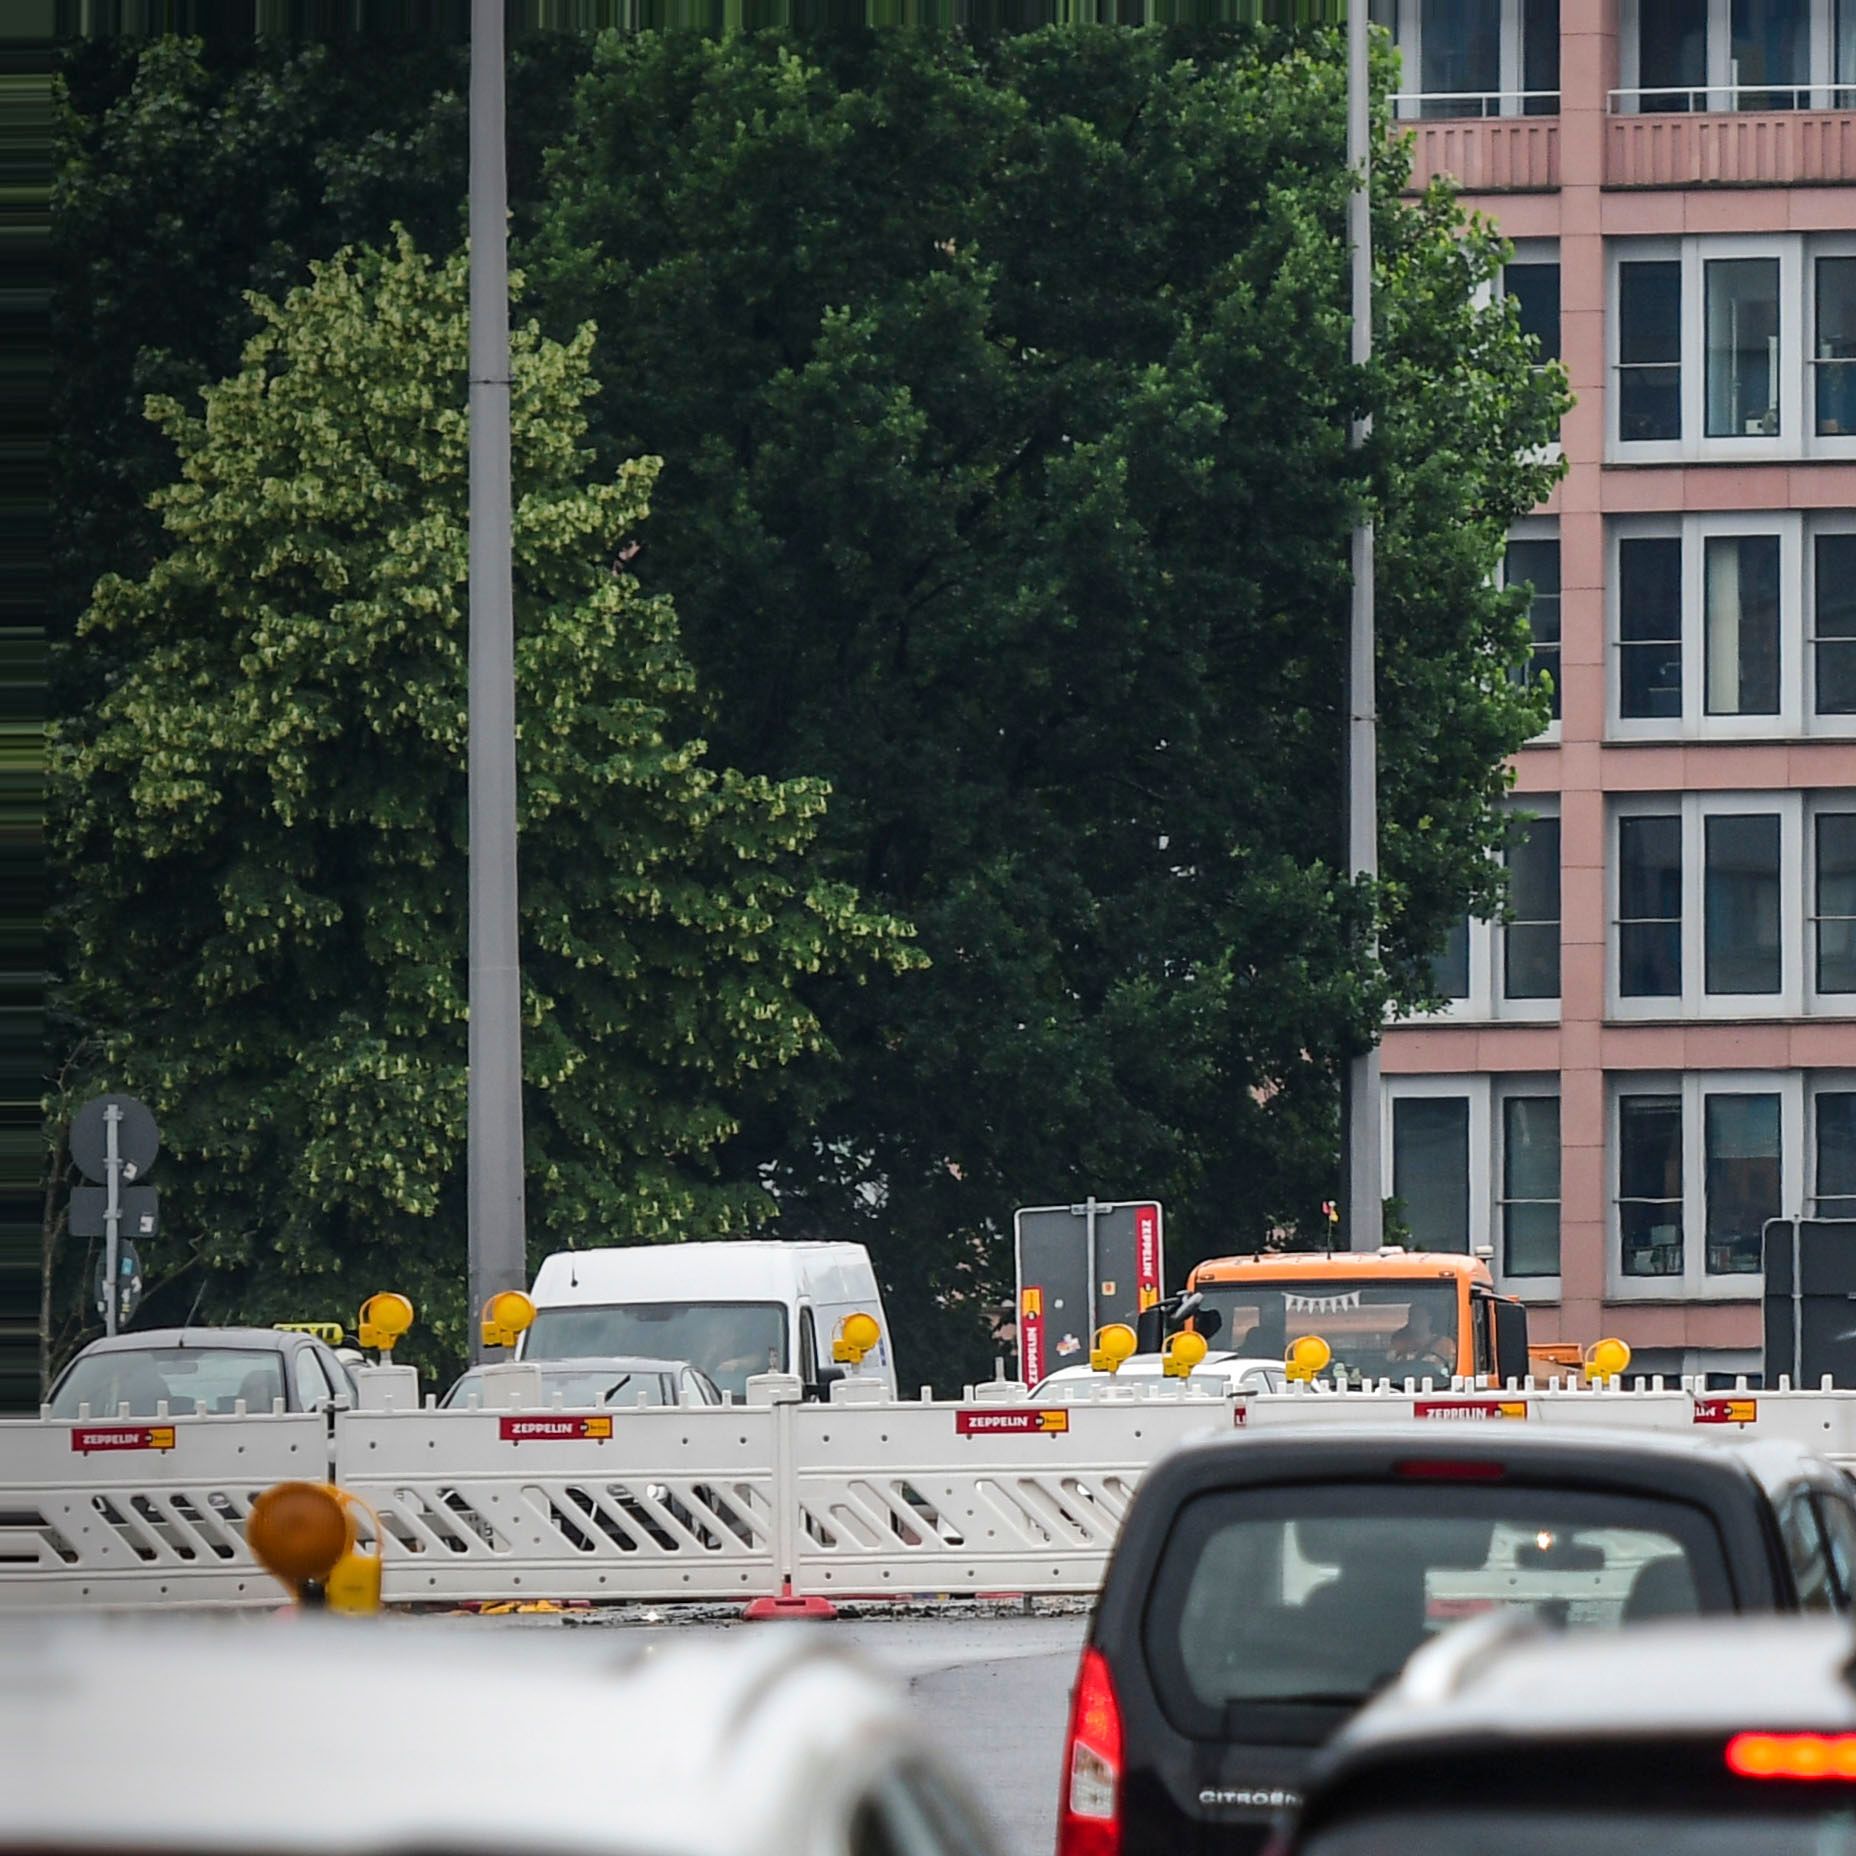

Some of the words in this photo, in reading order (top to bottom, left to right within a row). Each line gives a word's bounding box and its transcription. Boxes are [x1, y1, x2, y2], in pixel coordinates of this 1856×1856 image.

[1426, 1407, 1487, 1421] ZEPPELIN
[511, 1422, 574, 1434] ZEPPELIN
[968, 1416, 1029, 1428] ZEPPELIN
[82, 1434, 140, 1445] ZEPPELIN
